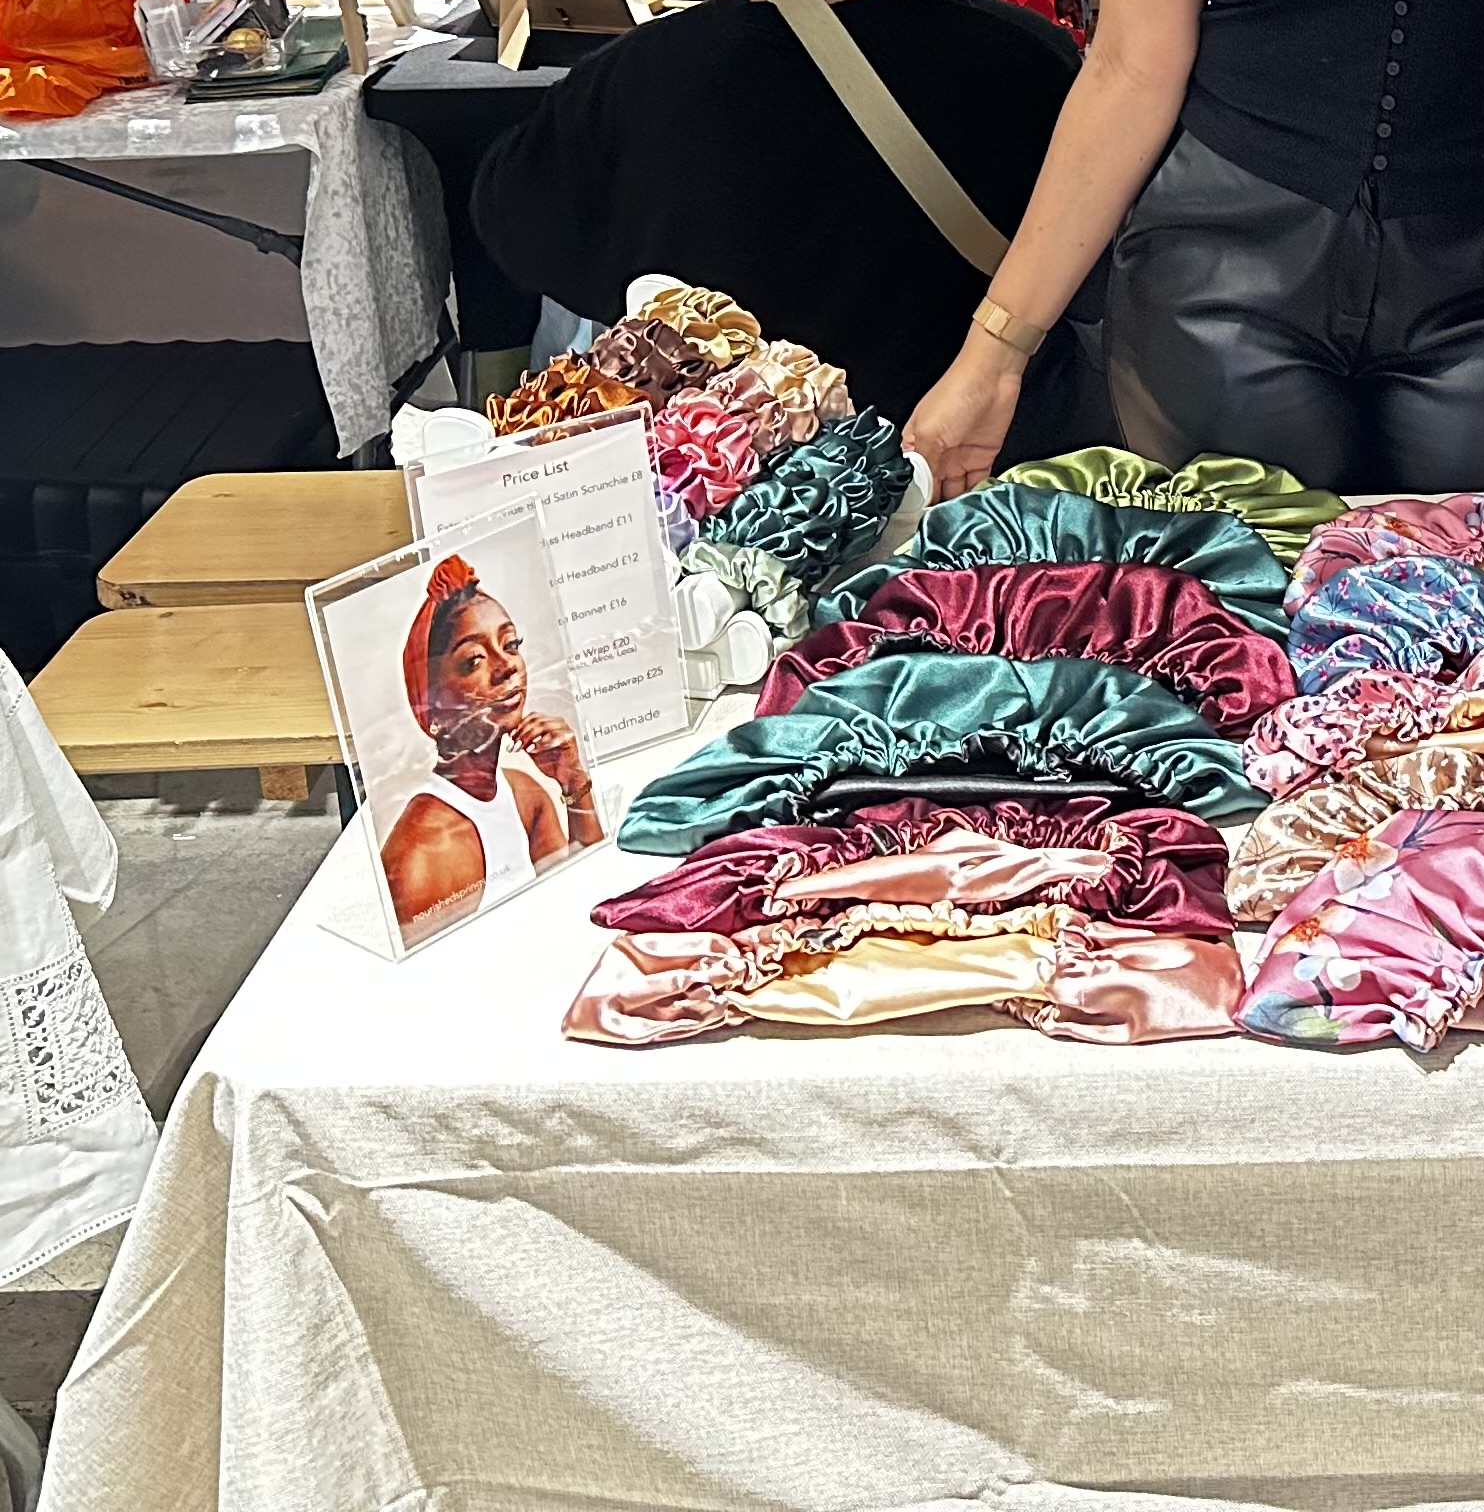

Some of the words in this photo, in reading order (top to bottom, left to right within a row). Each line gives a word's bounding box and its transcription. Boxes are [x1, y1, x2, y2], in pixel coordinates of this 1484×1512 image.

[503, 469, 539, 488] Price
[544, 460, 569, 478] List
[553, 489, 579, 504] Satin
[580, 475, 629, 496] Scrunchie
[561, 519, 614, 540] Headband
[616, 513, 633, 526] £11
[566, 558, 619, 580] Headband
[621, 552, 639, 567] £12
[571, 603, 607, 622] Bonnet
[609, 597, 627, 610] £16
[583, 644, 610, 660] Wrap
[612, 636, 630, 649] £20
[593, 672, 645, 696] Headwrap
[646, 666, 664, 680] £25
[593, 708, 661, 739] Handmade
